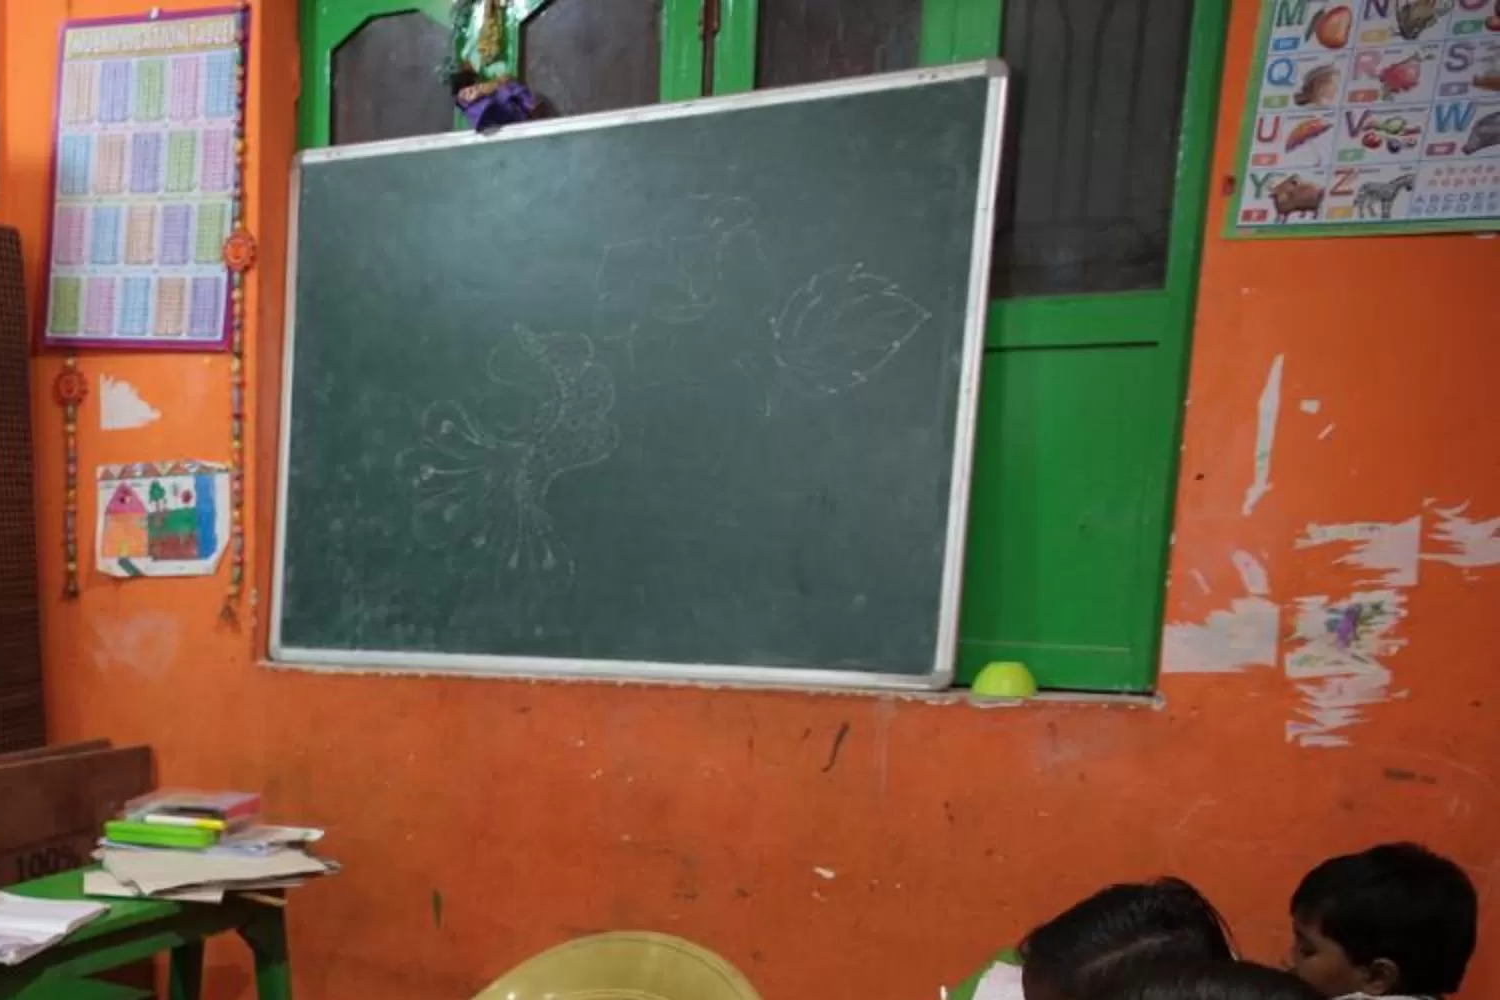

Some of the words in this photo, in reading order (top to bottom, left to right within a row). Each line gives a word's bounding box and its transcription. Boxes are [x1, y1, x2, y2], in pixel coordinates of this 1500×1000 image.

[1276, 0, 1306, 27] M
[1354, 50, 1382, 81] R
[1445, 43, 1474, 71] S
[1267, 57, 1294, 86] Q
[1257, 115, 1280, 143] U
[1345, 110, 1369, 137] V
[1435, 103, 1474, 133] W
[1249, 172, 1271, 199] Y
[1329, 168, 1355, 196] Z
